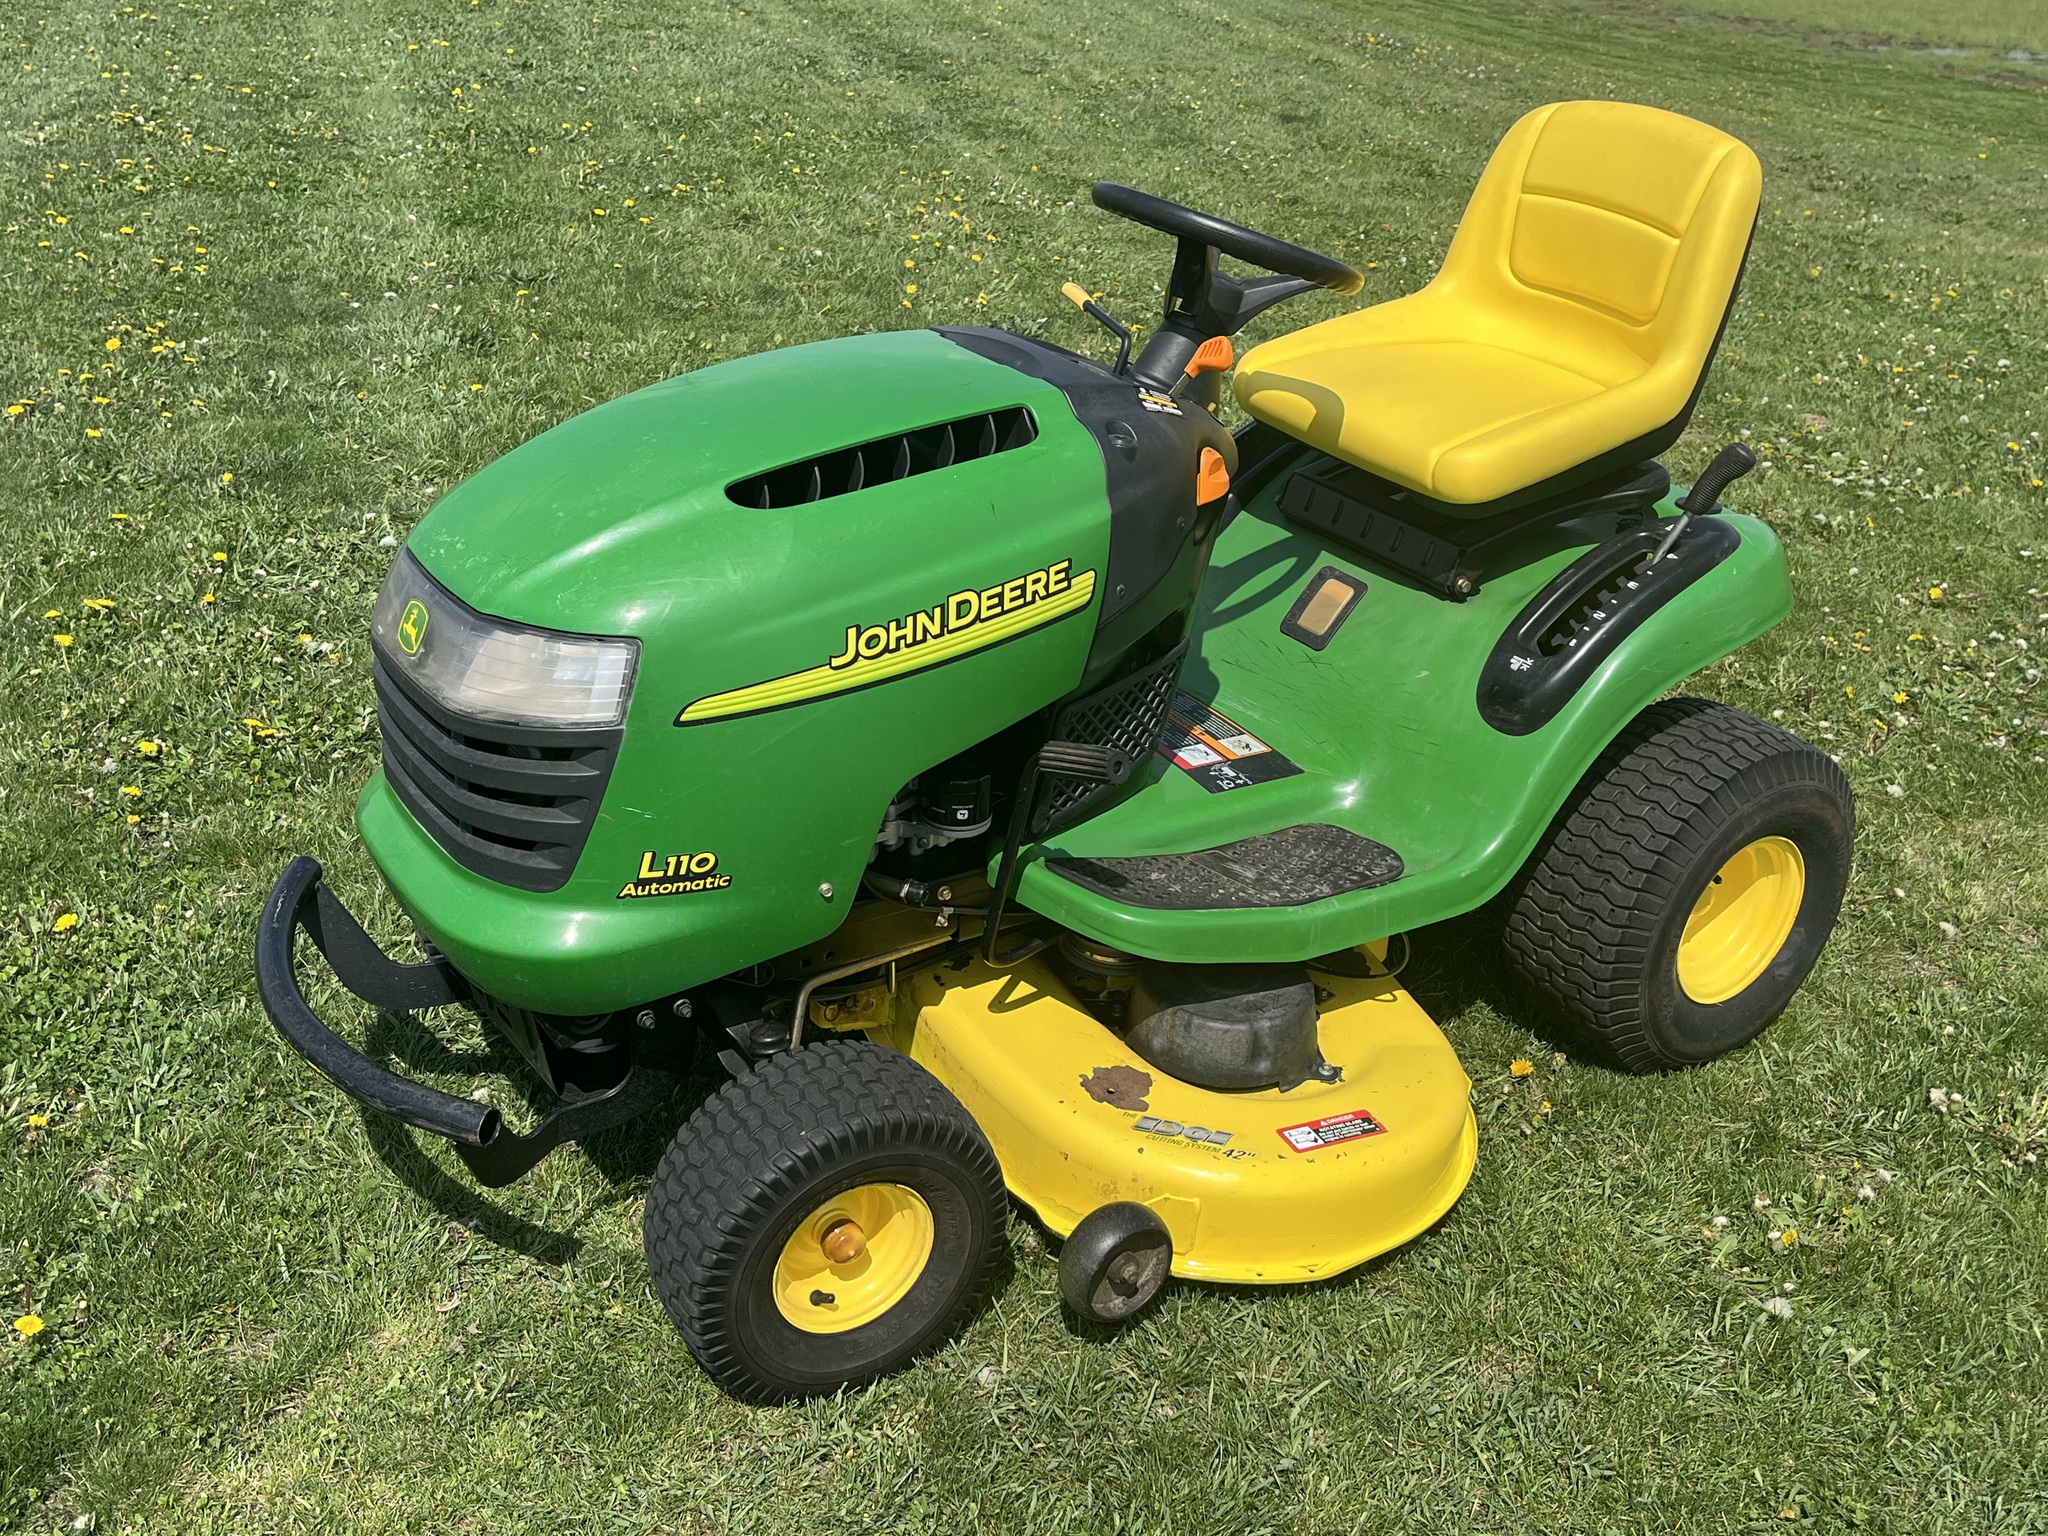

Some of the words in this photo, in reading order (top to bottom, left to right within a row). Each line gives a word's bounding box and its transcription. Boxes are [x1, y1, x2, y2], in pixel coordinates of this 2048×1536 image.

[830, 605, 944, 668] JOHN
[947, 559, 1071, 632] DEERE
[638, 851, 717, 879] L110
[618, 874, 731, 898] Automatic
[1121, 1111, 1140, 1119] THE
[1325, 1113, 1355, 1124] DANGER
[1131, 1115, 1235, 1146] EDGE
[1145, 1133, 1186, 1147] CUTTING
[1184, 1141, 1222, 1154] SYSTEM
[1221, 1148, 1257, 1161] 42"
